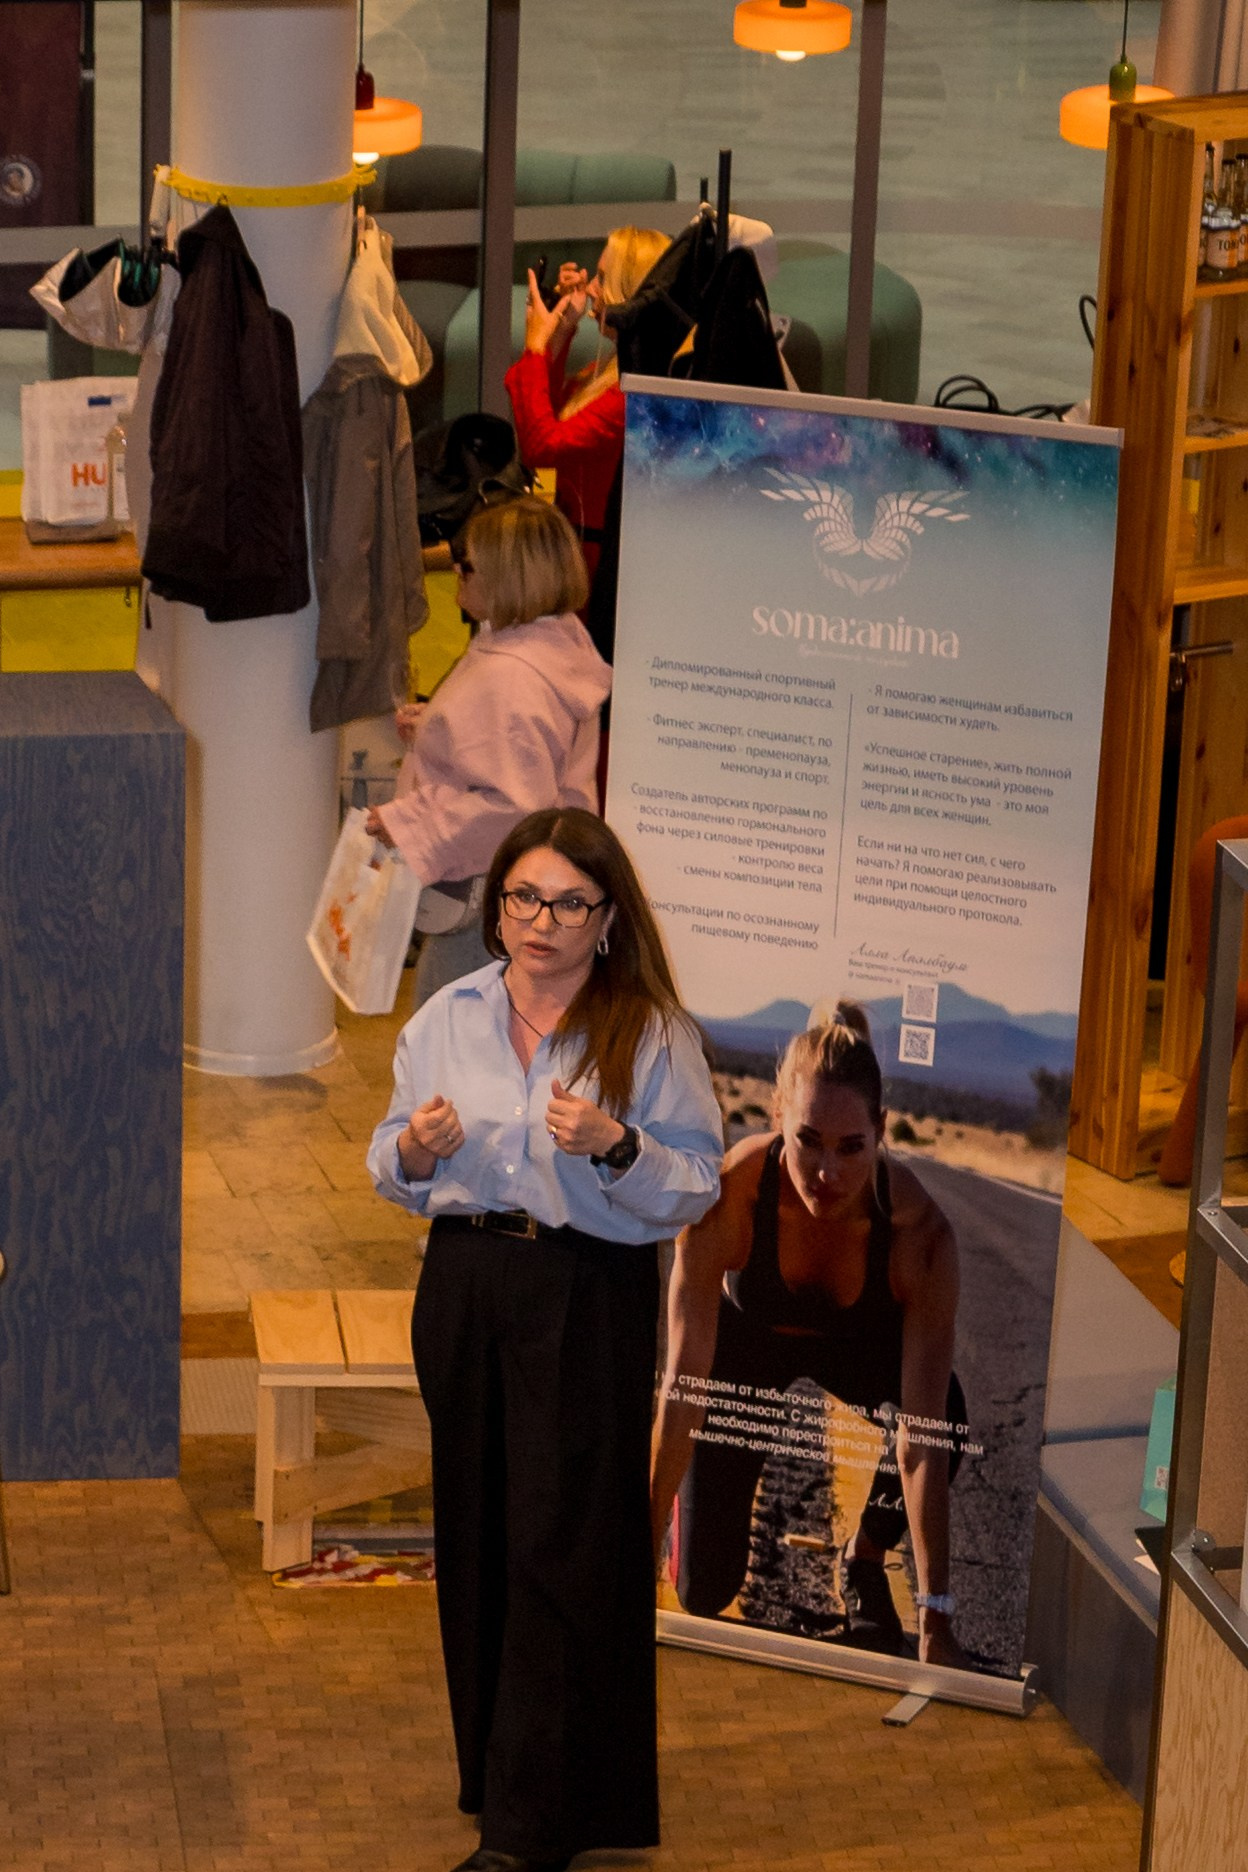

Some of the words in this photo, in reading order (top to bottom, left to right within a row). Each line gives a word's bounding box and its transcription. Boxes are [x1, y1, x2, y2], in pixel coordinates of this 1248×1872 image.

[752, 606, 960, 660] soma:anima
[648, 676, 688, 693] тренер
[690, 681, 791, 703] международного
[651, 656, 762, 681] Дипломированный
[764, 672, 835, 690] спортивный
[866, 705, 879, 716] от
[883, 707, 957, 726] зависимости
[959, 717, 999, 732] худеть.
[874, 684, 882, 697] Я
[885, 688, 936, 704] помогаю
[939, 695, 1001, 713] женщинам
[1003, 702, 1072, 722] избавиться
[652, 713, 694, 731] Фитнес
[746, 728, 815, 748] специалист,
[817, 737, 832, 748] по
[658, 734, 736, 754] направлению
[745, 745, 832, 767] пременопауза,
[864, 742, 927, 761] «Успешное
[993, 760, 1023, 773] жить
[1025, 764, 1071, 780] полной
[720, 760, 781, 778] менопауза
[784, 769, 792, 779] и
[794, 770, 829, 785] спорт.
[862, 762, 910, 779] жизнью,
[913, 769, 948, 783] иметь
[951, 774, 1000, 790] высокий
[1003, 781, 1053, 797] уровень
[630, 782, 688, 802] Создатель
[691, 792, 749, 809] авторских
[752, 800, 810, 817] программ
[812, 808, 828, 819] по
[860, 799, 887, 812] цель
[889, 802, 911, 815] для
[913, 806, 939, 818] всех
[941, 809, 991, 825] женщин.
[861, 781, 909, 796] энергии
[911, 787, 919, 798] и
[921, 789, 967, 804] ясность
[970, 795, 991, 808] ума
[1003, 799, 1022, 811] это
[1024, 802, 1048, 814] моя
[636, 820, 664, 835] фона
[667, 826, 701, 841] через
[703, 831, 753, 847] силовые
[756, 837, 824, 856] тренировки
[639, 804, 735, 826] восстановлению
[737, 817, 826, 838] гормонального
[738, 854, 795, 871] контролю
[797, 862, 823, 874] веса
[857, 836, 884, 851] Если
[886, 842, 901, 854] ни
[904, 845, 917, 856] на
[920, 847, 940, 859] что
[942, 850, 962, 862] нет
[964, 853, 987, 867] сил,
[990, 856, 995, 867] с
[999, 858, 1025, 871] чего
[683, 865, 721, 879] смены
[723, 870, 794, 889] композиции
[797, 880, 822, 892] тела
[854, 875, 883, 888] цели
[885, 879, 907, 893] при
[910, 882, 958, 899] помощи
[960, 889, 1027, 908] целостного
[855, 856, 900, 871] начать?
[902, 860, 910, 873] Я
[912, 864, 964, 880] помогаю
[966, 871, 1056, 893] реализовывать
[648, 897, 724, 918] онсультации
[726, 909, 741, 920] по
[743, 911, 819, 932] осознанному
[853, 892, 956, 917] индивидуального
[958, 907, 1022, 926] протокола.
[691, 923, 750, 943] пищевому
[753, 931, 818, 949] поведению
[678, 1374, 736, 1394] страдаем
[738, 1385, 752, 1397] от
[754, 1387, 832, 1411] избыточного
[872, 1408, 892, 1421] мы
[894, 1412, 952, 1432] страдаем
[956, 1422, 970, 1435] от
[682, 1392, 787, 1420] недостаточности.
[790, 1408, 800, 1422] С
[802, 1413, 887, 1438] жирофобного
[960, 1441, 984, 1455] нам
[707, 1414, 780, 1436] необходимо
[782, 1427, 871, 1452] перестроиться
[874, 1443, 889, 1455] на
